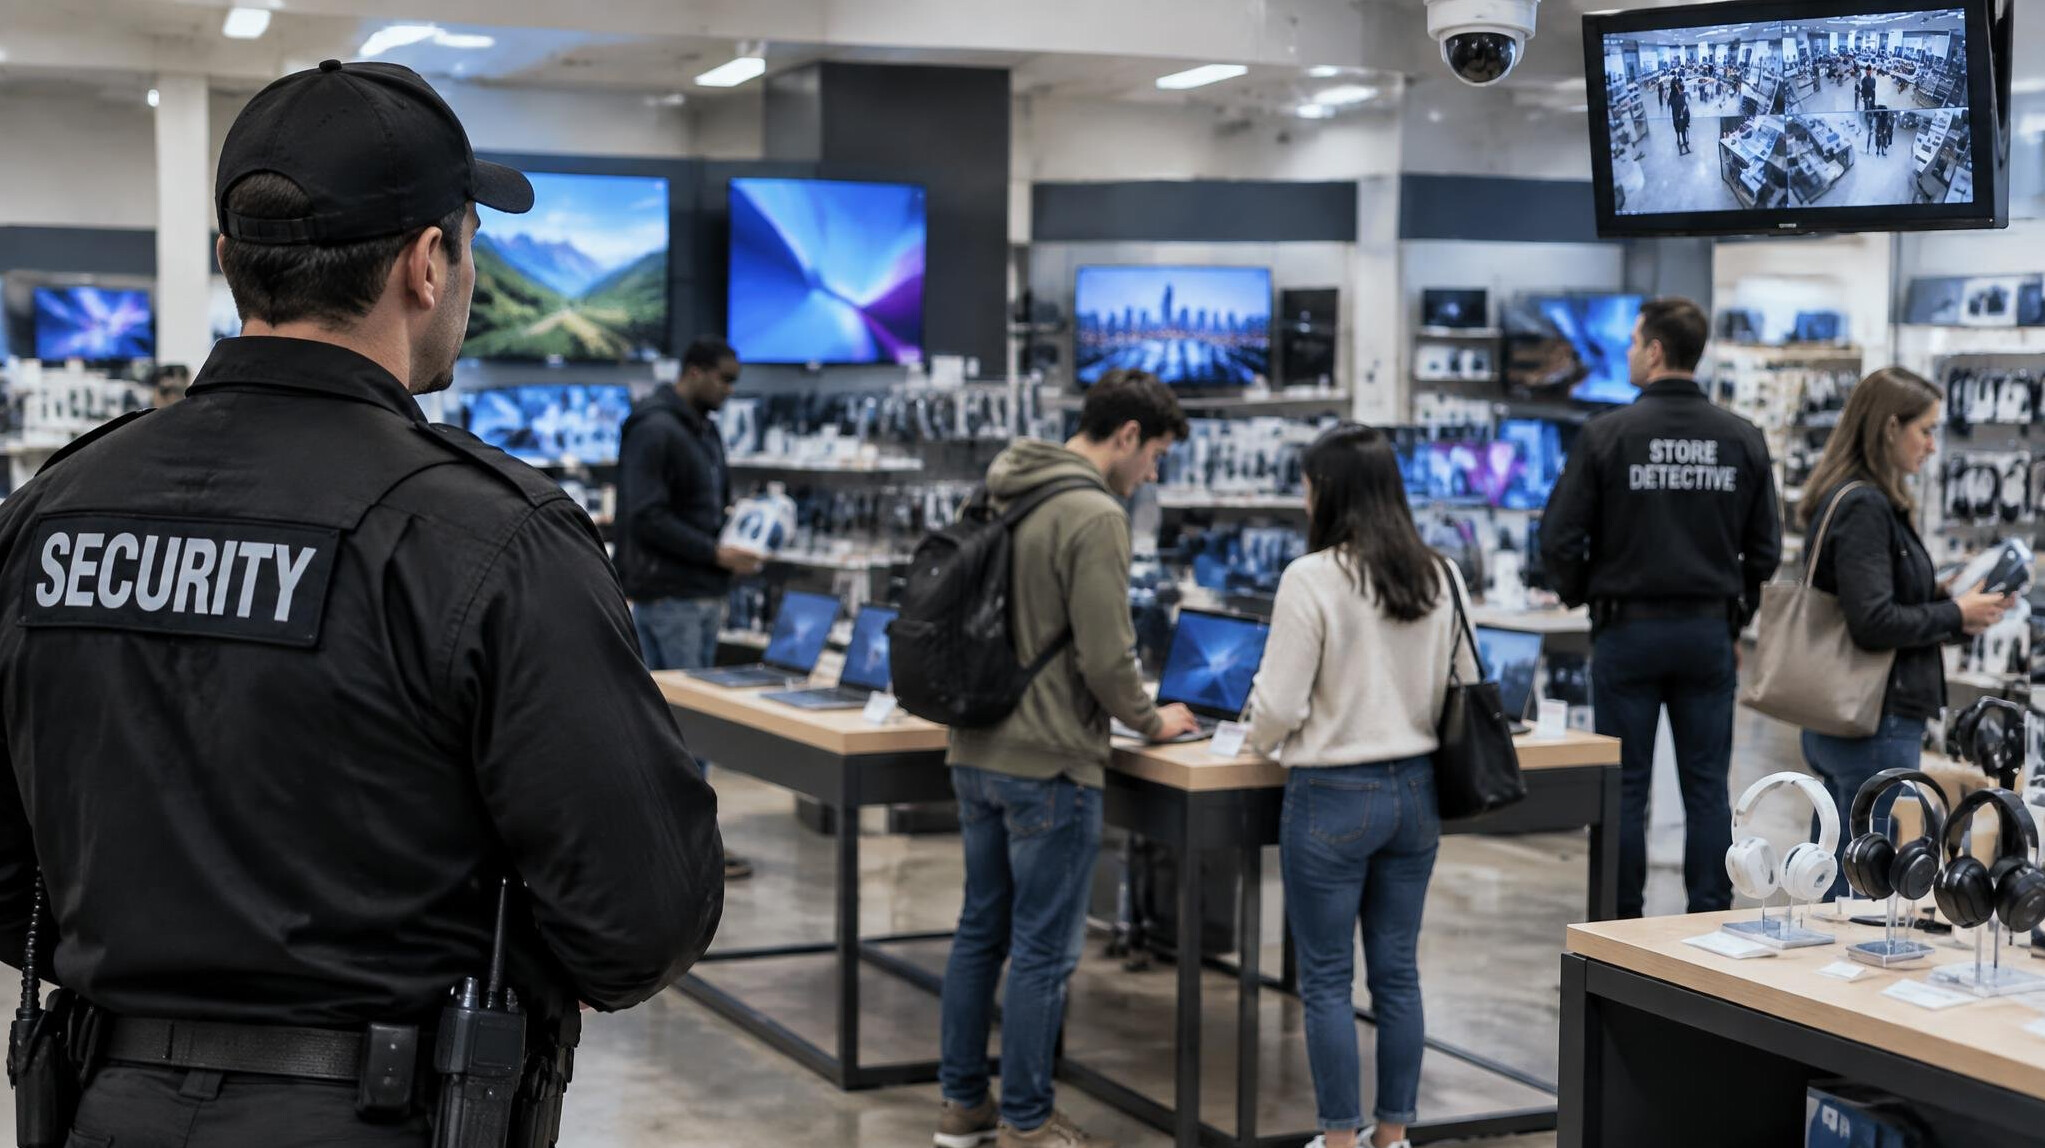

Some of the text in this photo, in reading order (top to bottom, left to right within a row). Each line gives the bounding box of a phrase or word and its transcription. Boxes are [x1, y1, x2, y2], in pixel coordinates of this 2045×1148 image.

[1649, 438, 1718, 465] STORE
[1629, 464, 1737, 492] DETECTIVE
[36, 532, 317, 622] SECURITY
